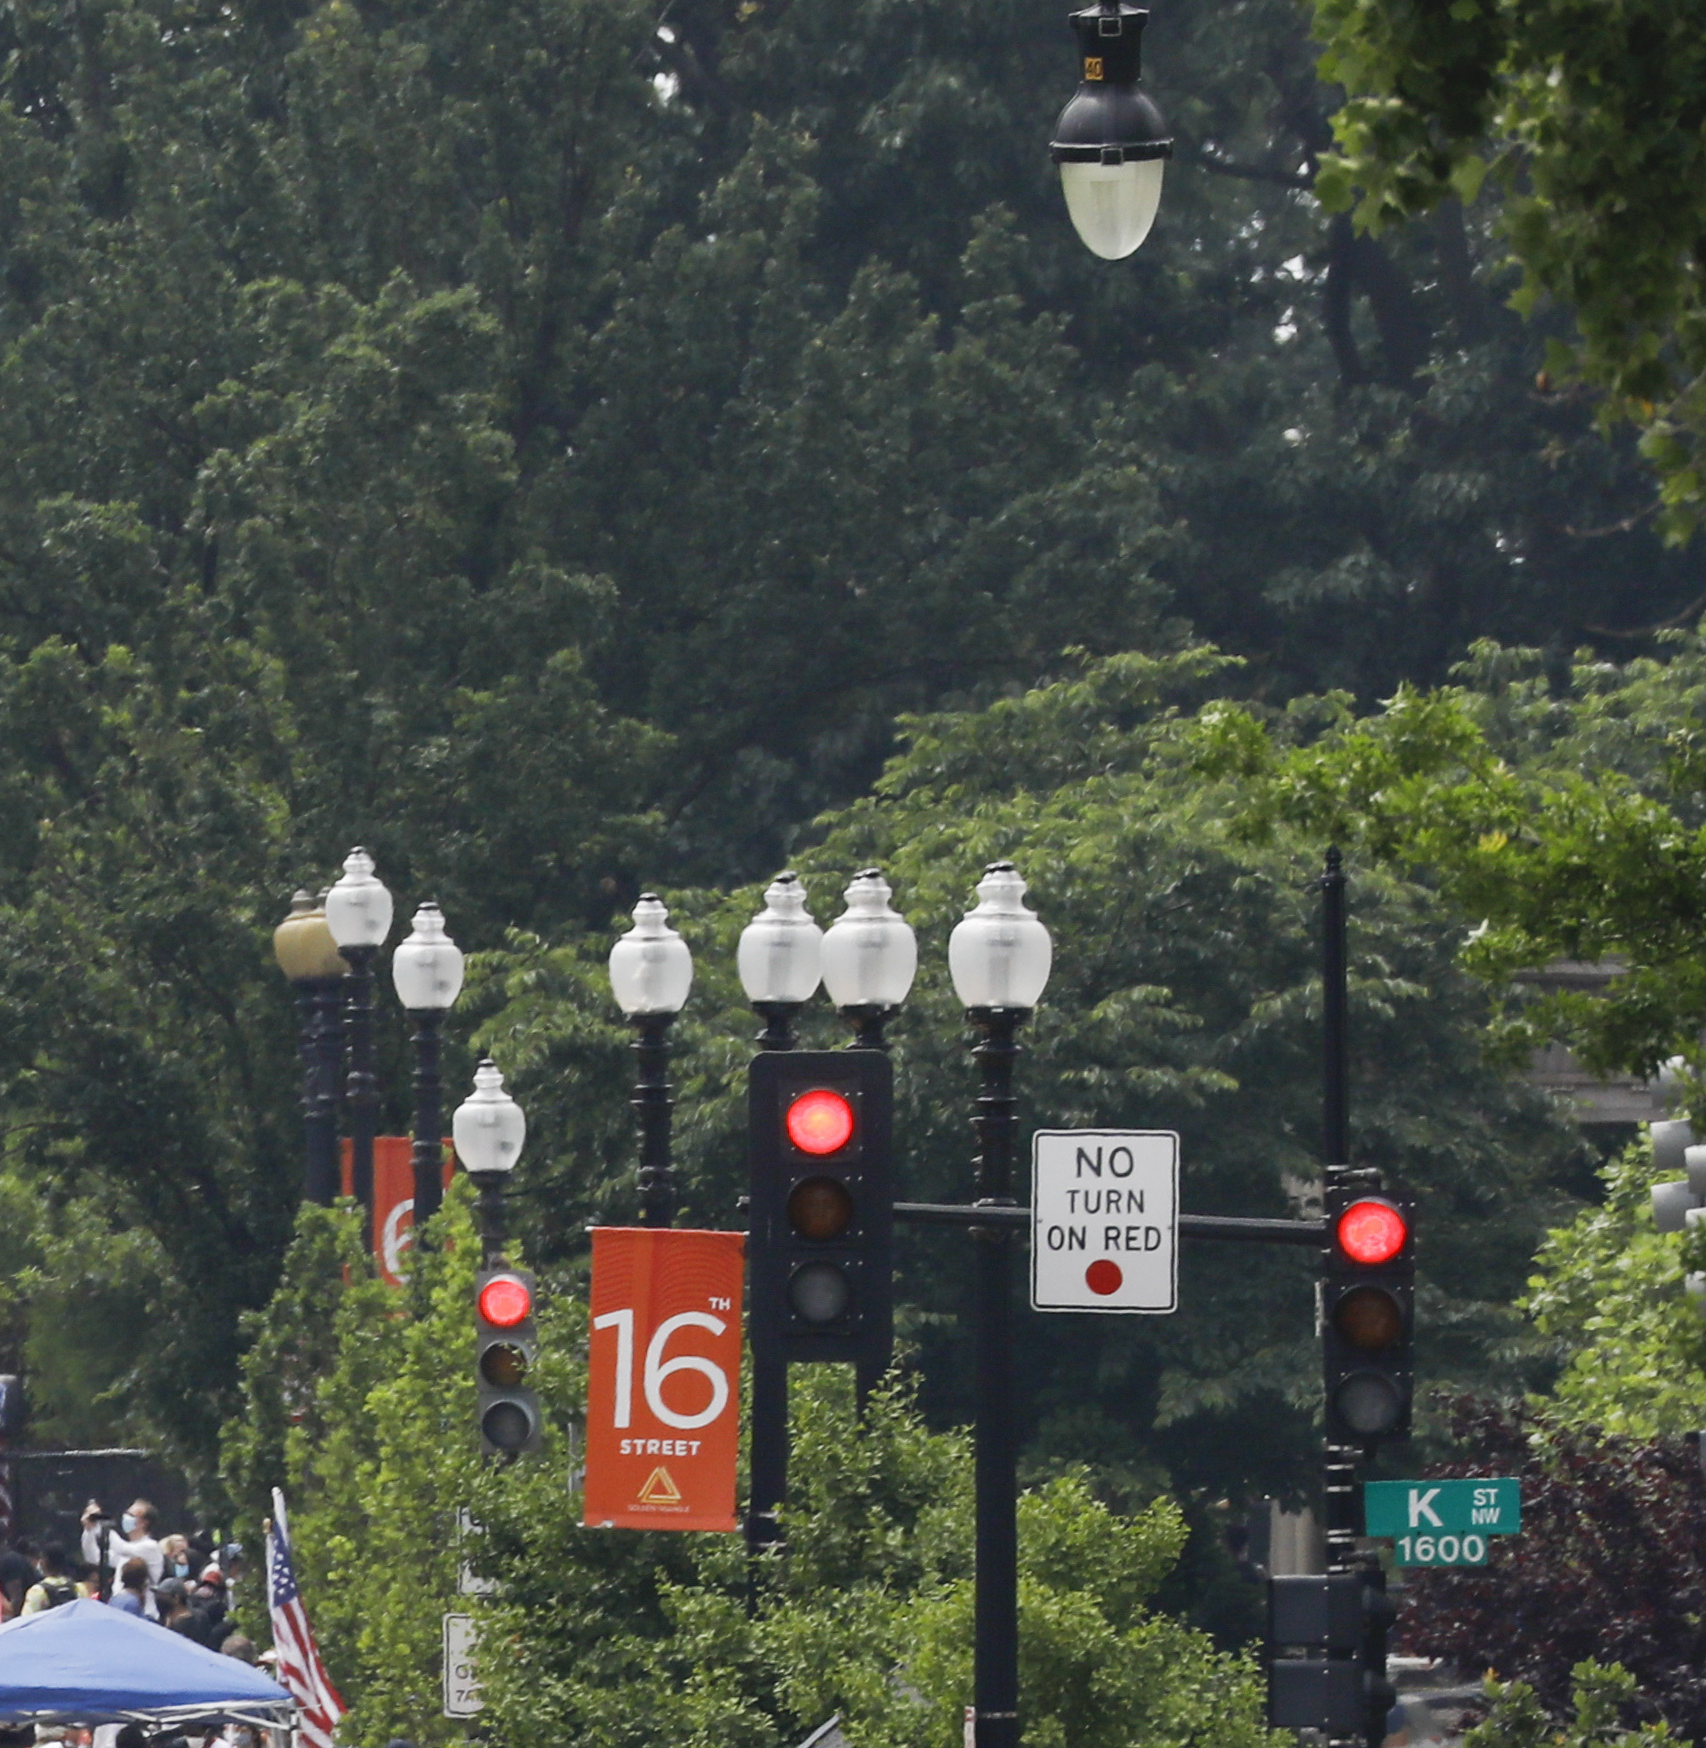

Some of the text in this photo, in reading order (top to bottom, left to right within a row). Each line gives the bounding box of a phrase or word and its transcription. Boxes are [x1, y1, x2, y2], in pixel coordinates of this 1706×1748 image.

[1076, 1146, 1134, 1178] NO
[1066, 1189, 1144, 1214] TURN
[1047, 1225, 1161, 1250] ON RED
[593, 1297, 731, 1429] 16 TH
[619, 1438, 701, 1456] STREET
[1408, 1488, 1498, 1528] K ST
[1471, 1507, 1500, 1525] NW
[1398, 1534, 1484, 1562] 1600
